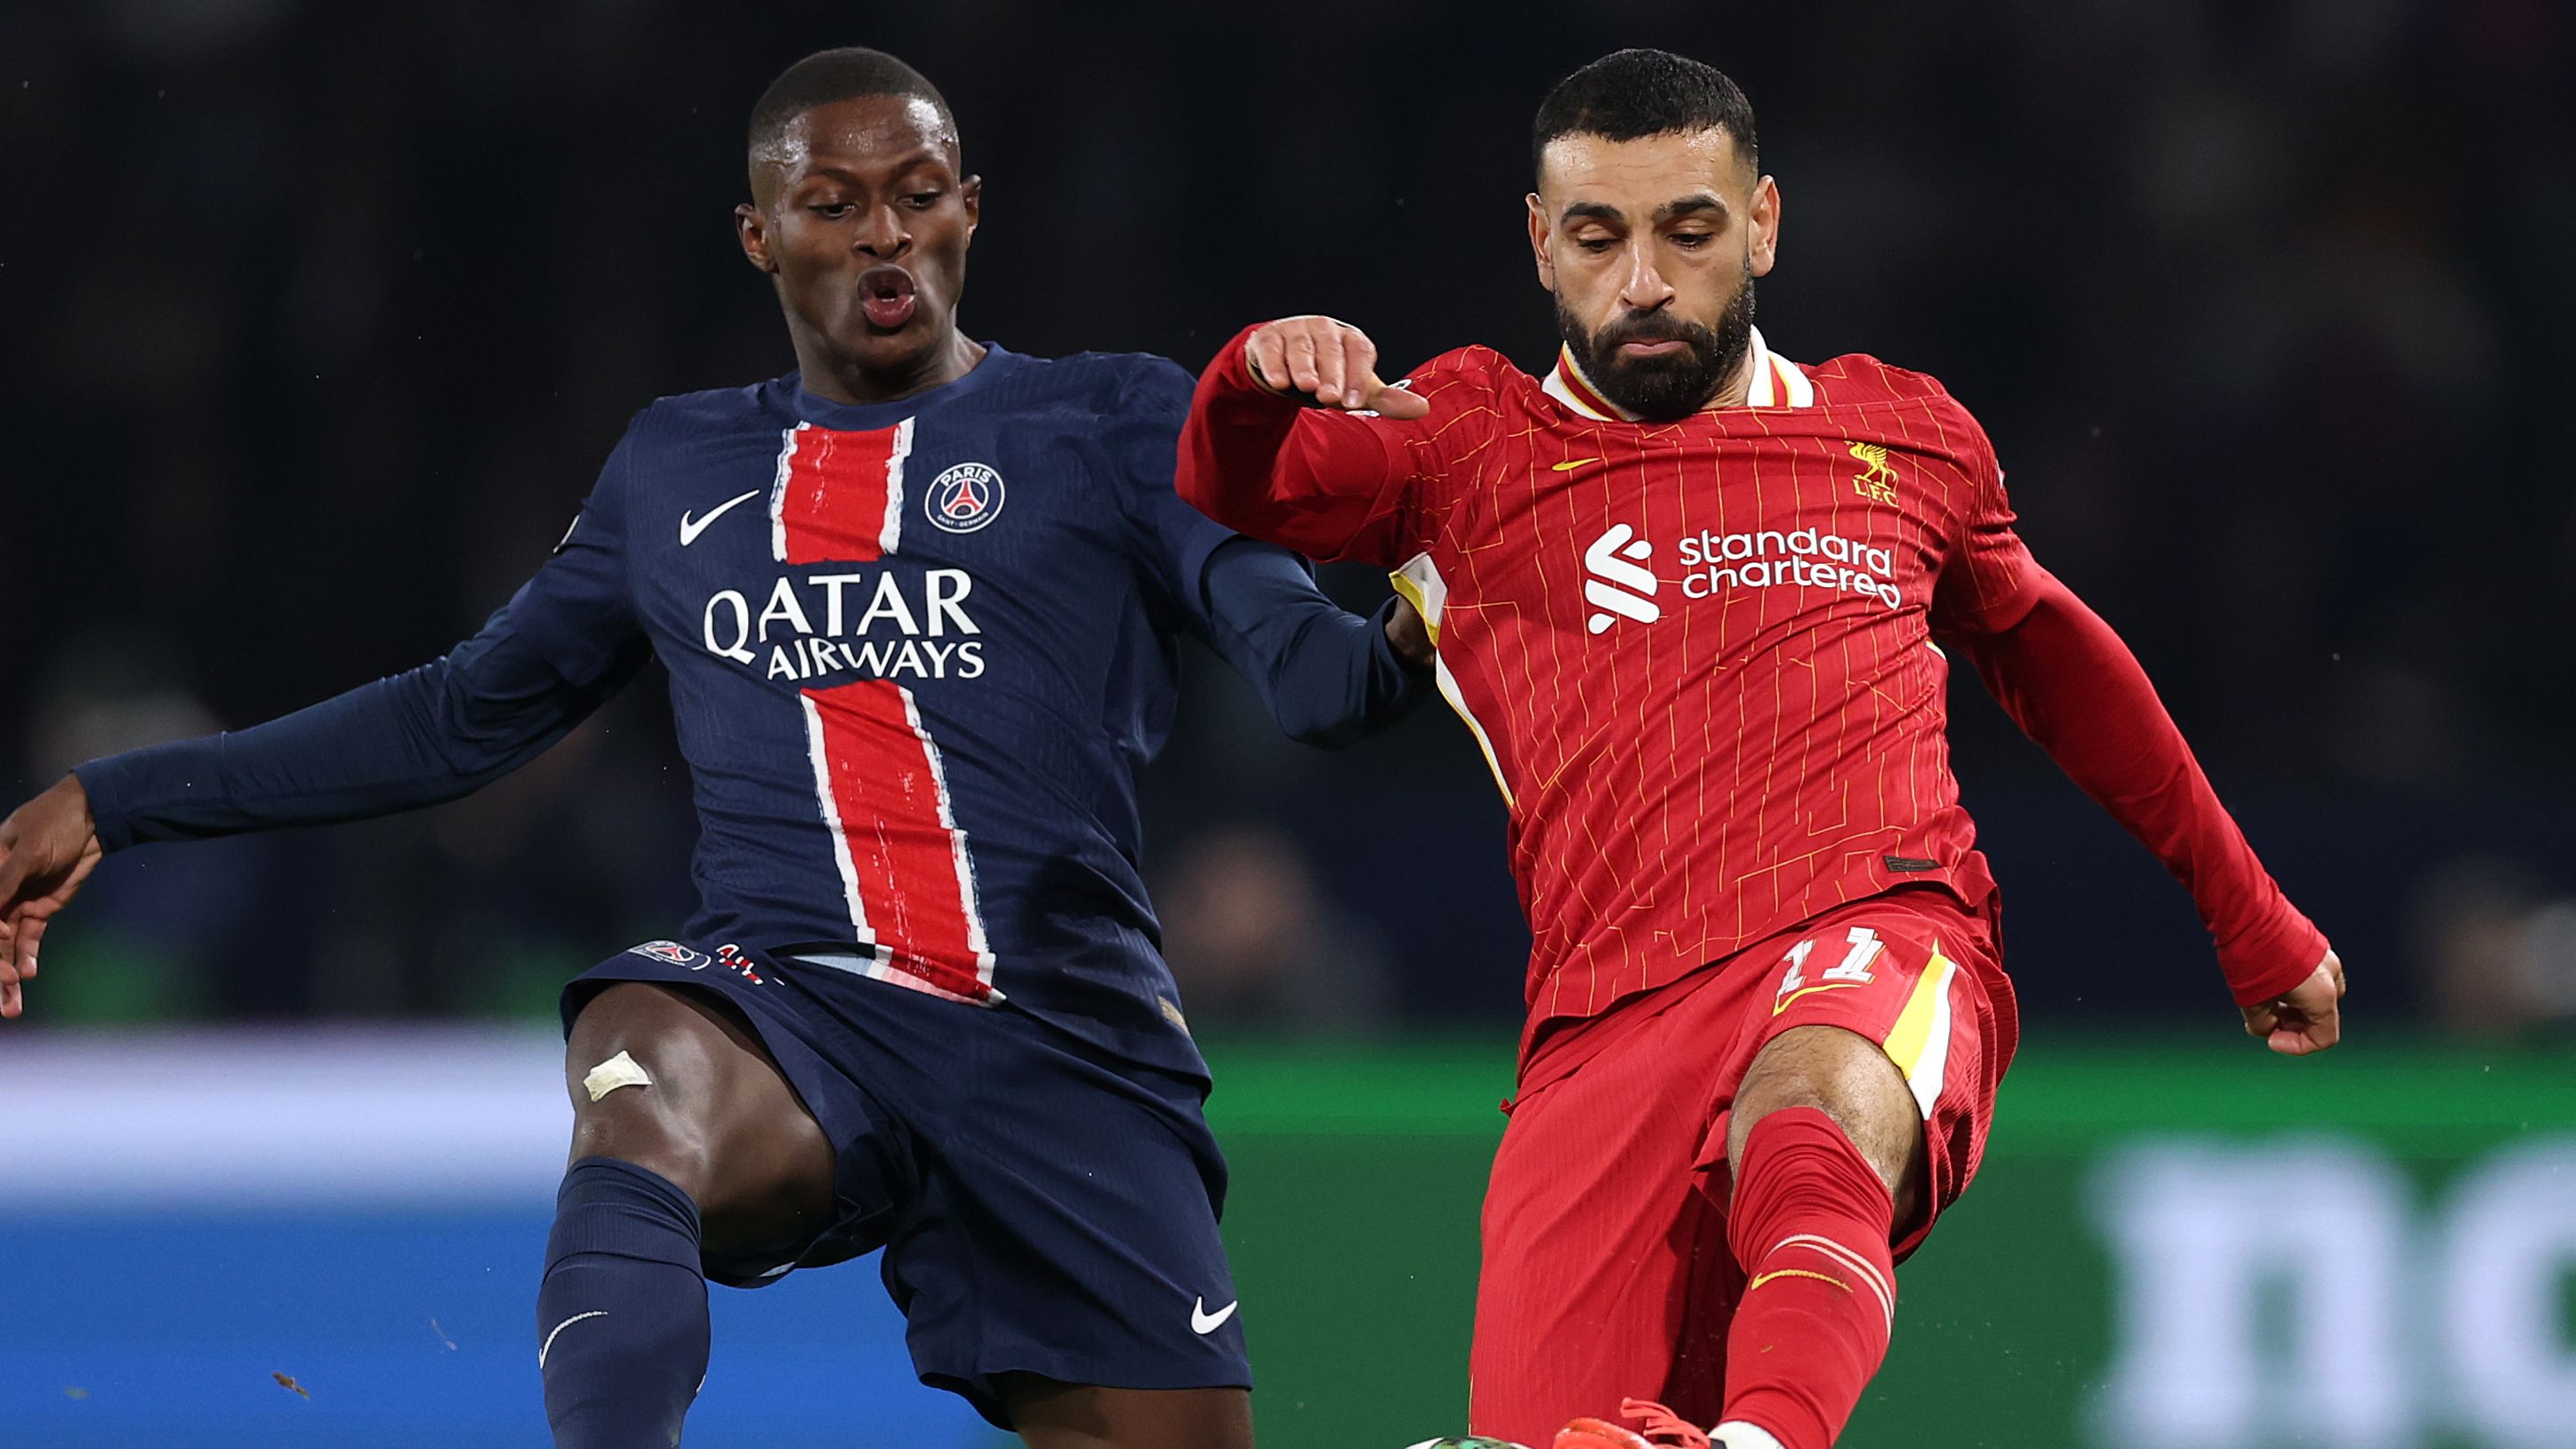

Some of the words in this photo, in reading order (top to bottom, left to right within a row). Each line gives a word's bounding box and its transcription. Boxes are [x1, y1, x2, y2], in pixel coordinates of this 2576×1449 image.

[940, 466, 992, 487] PARIS
[1678, 527, 1891, 578] standard
[1682, 555, 1901, 609] chartered
[704, 568, 981, 664] QATAR
[768, 637, 985, 680] AIRWAYS
[1777, 927, 1886, 997] 11
